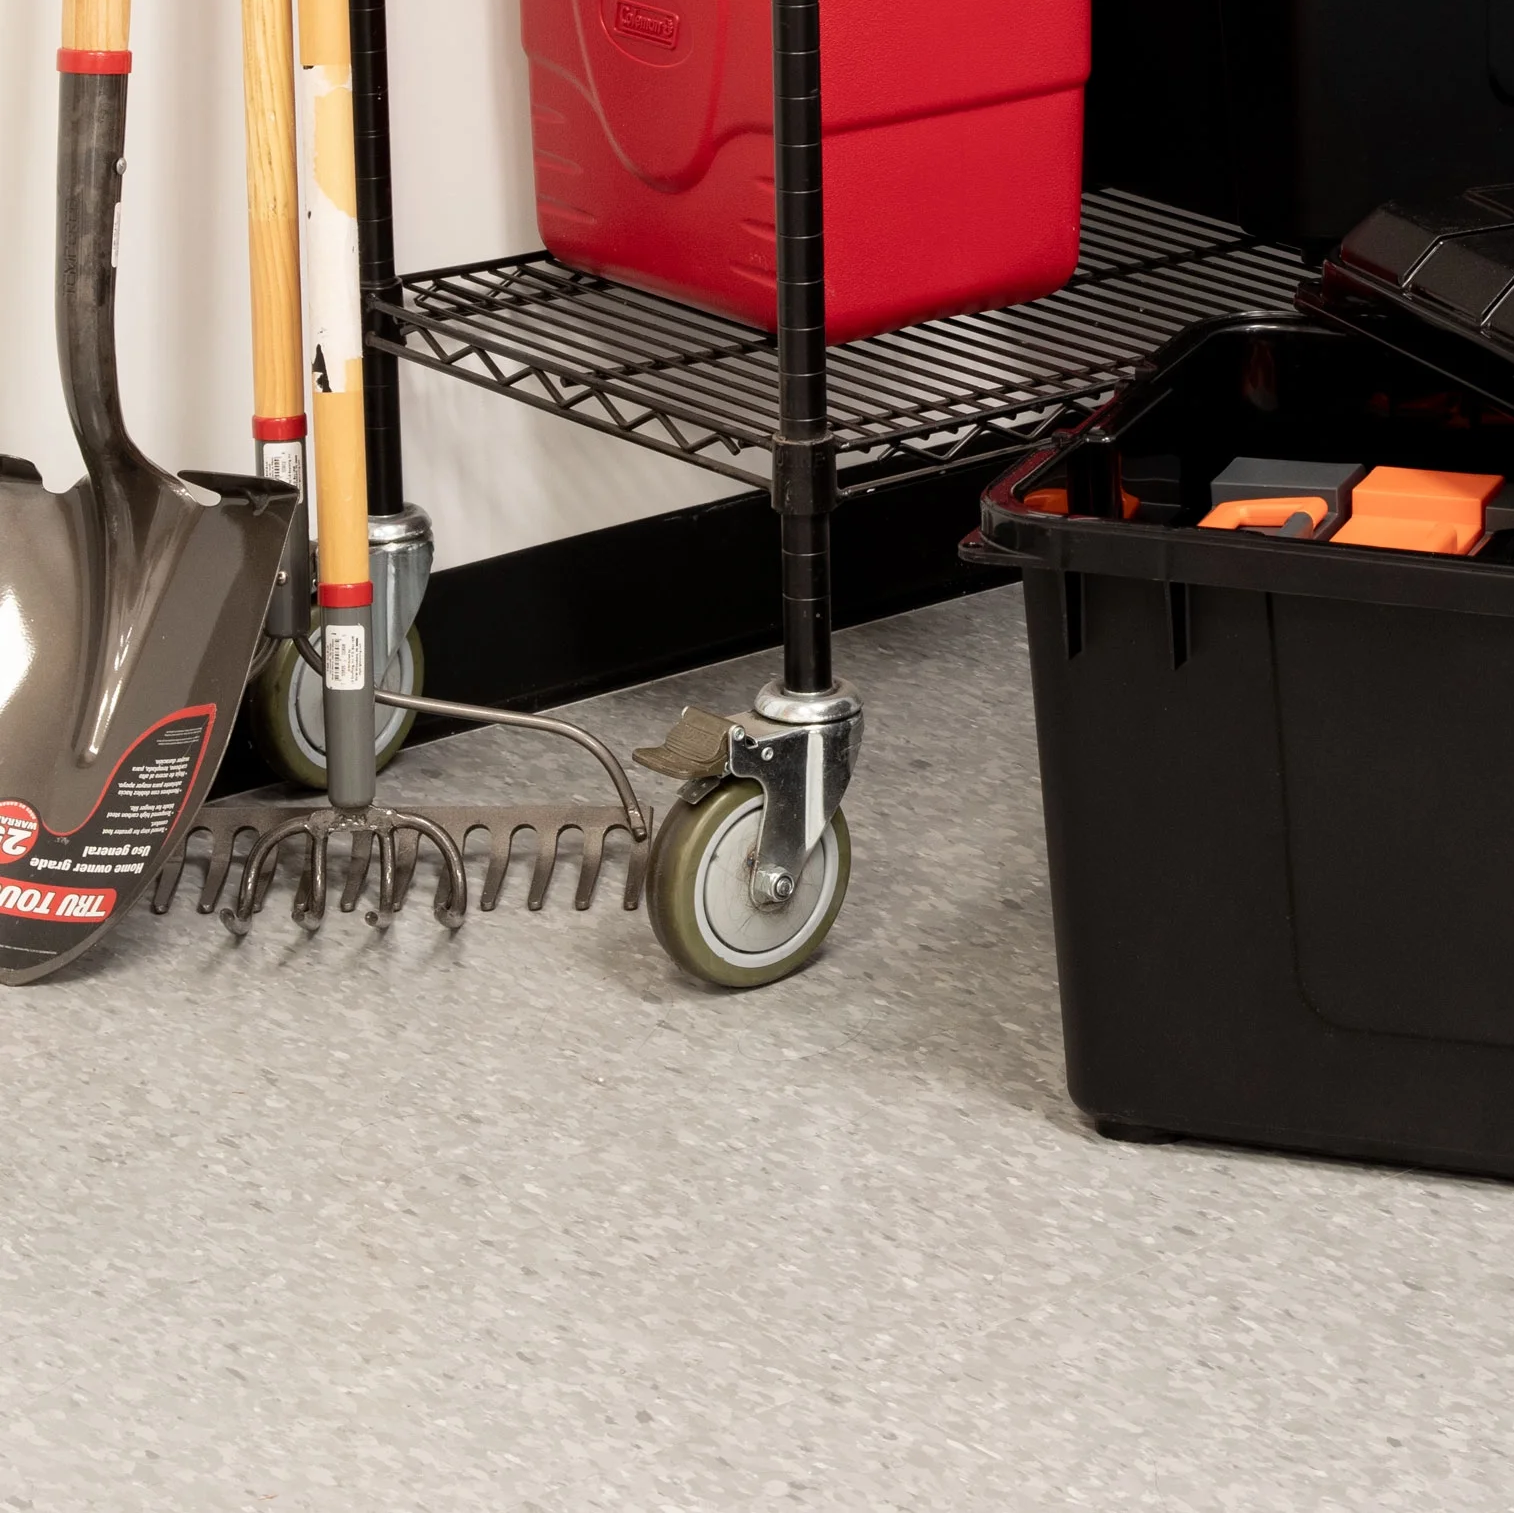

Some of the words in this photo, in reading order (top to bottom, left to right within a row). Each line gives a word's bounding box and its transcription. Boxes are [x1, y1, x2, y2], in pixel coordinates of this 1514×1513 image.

[0, 816, 37, 830] WARRA
[82, 844, 130, 857] general
[131, 845, 151, 857] Uso
[29, 857, 72, 871] grade
[73, 863, 112, 874] owner
[115, 862, 144, 874] Home
[0, 886, 55, 914] TOU
[56, 894, 105, 918] TRU
